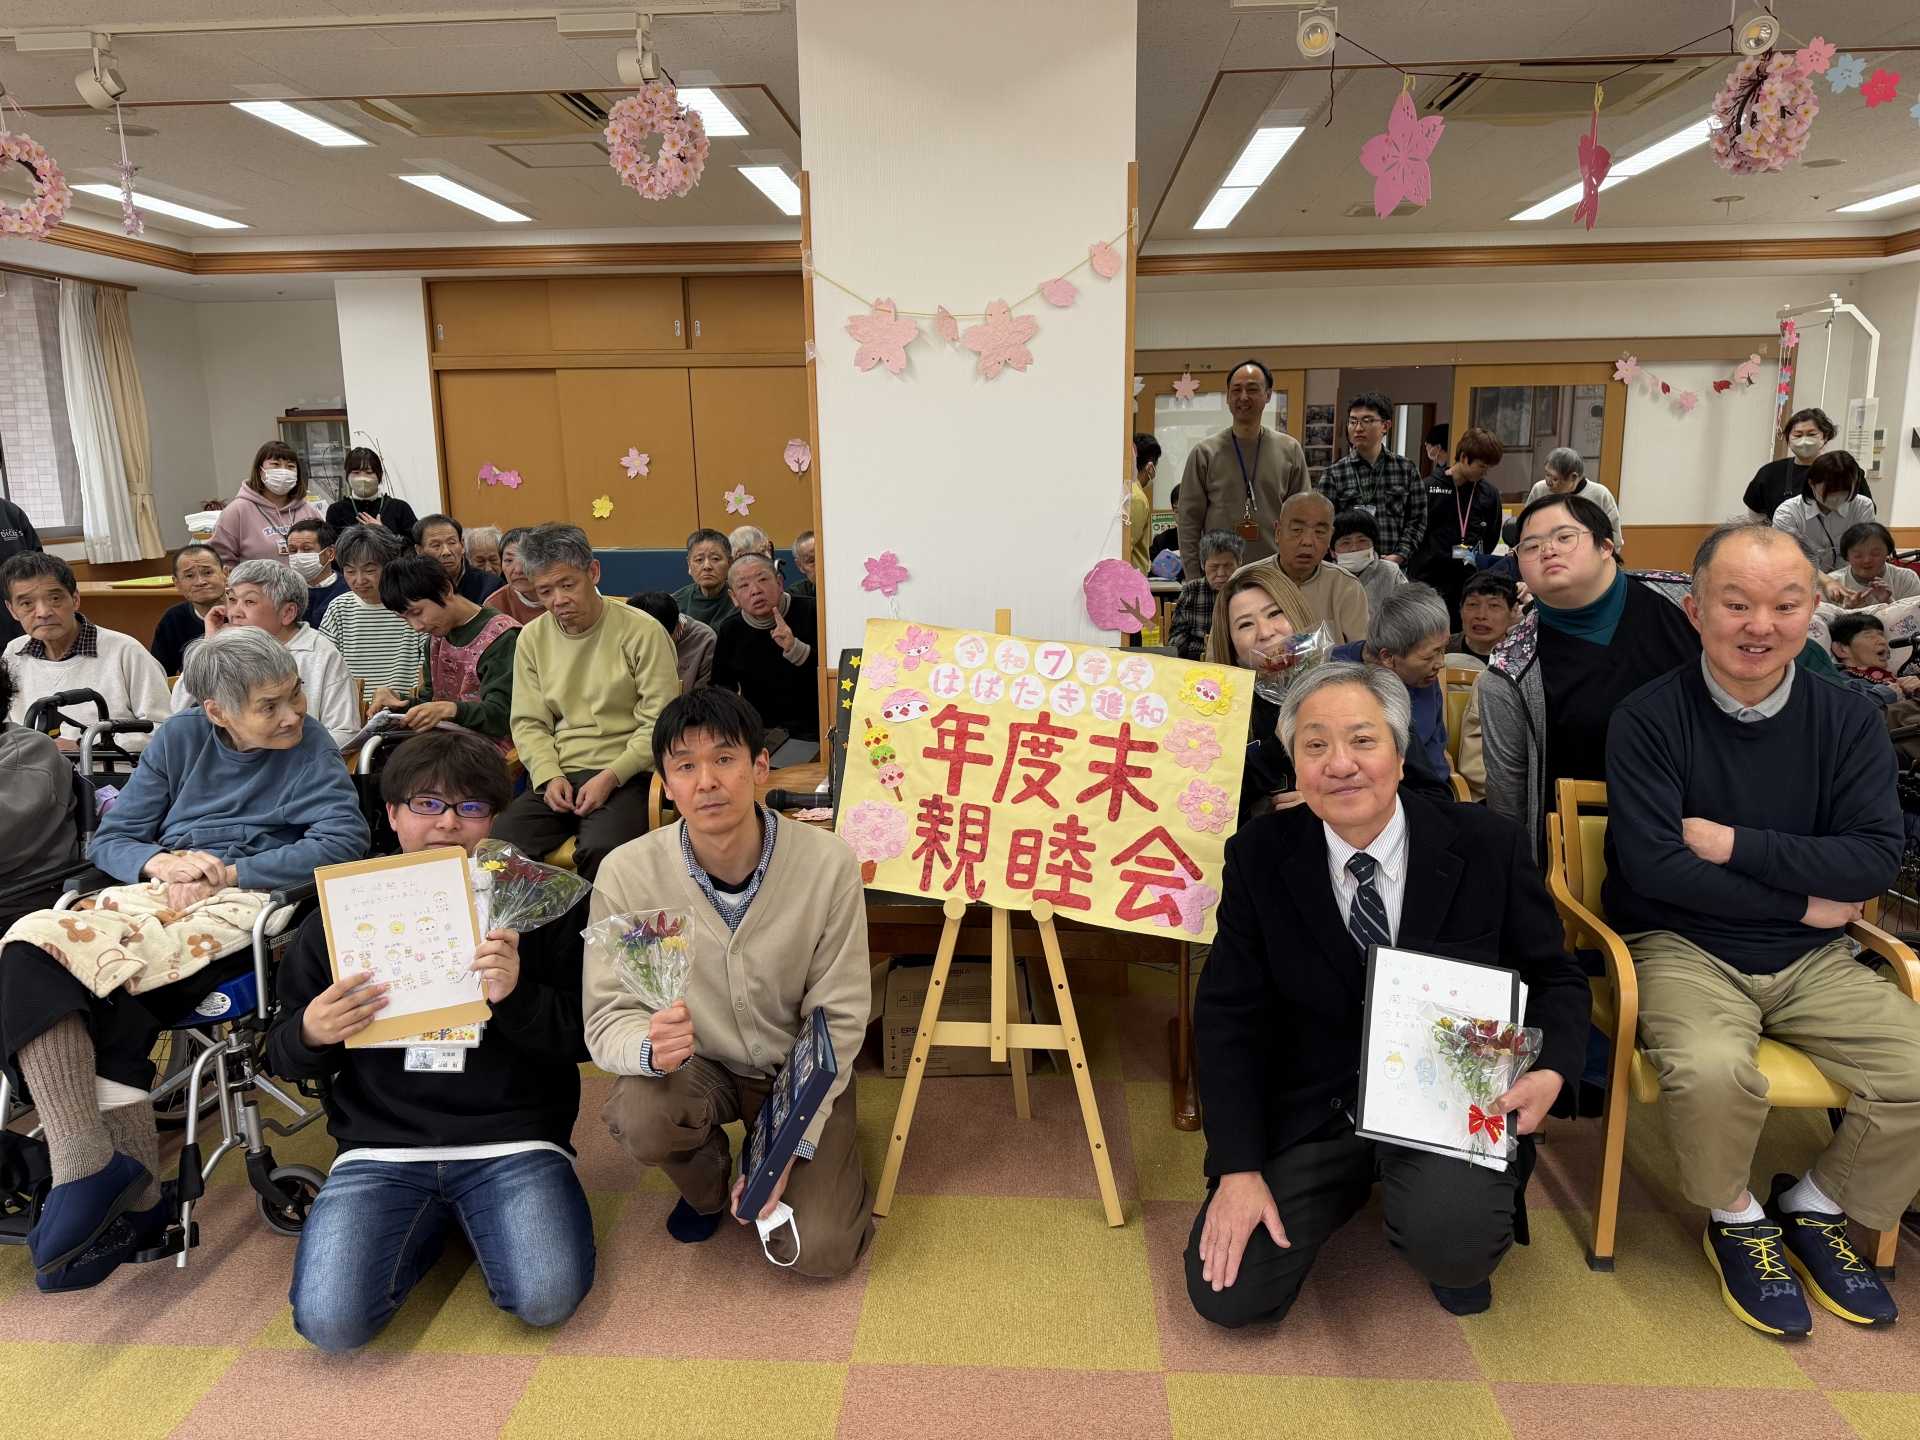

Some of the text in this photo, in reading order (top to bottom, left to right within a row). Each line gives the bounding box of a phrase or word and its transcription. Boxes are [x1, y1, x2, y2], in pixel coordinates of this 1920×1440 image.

[932, 667, 1165, 723] はばたき進和
[957, 637, 1146, 690] 令和7年度
[922, 704, 1159, 821] 年度末
[912, 794, 1203, 926] 親睦会
